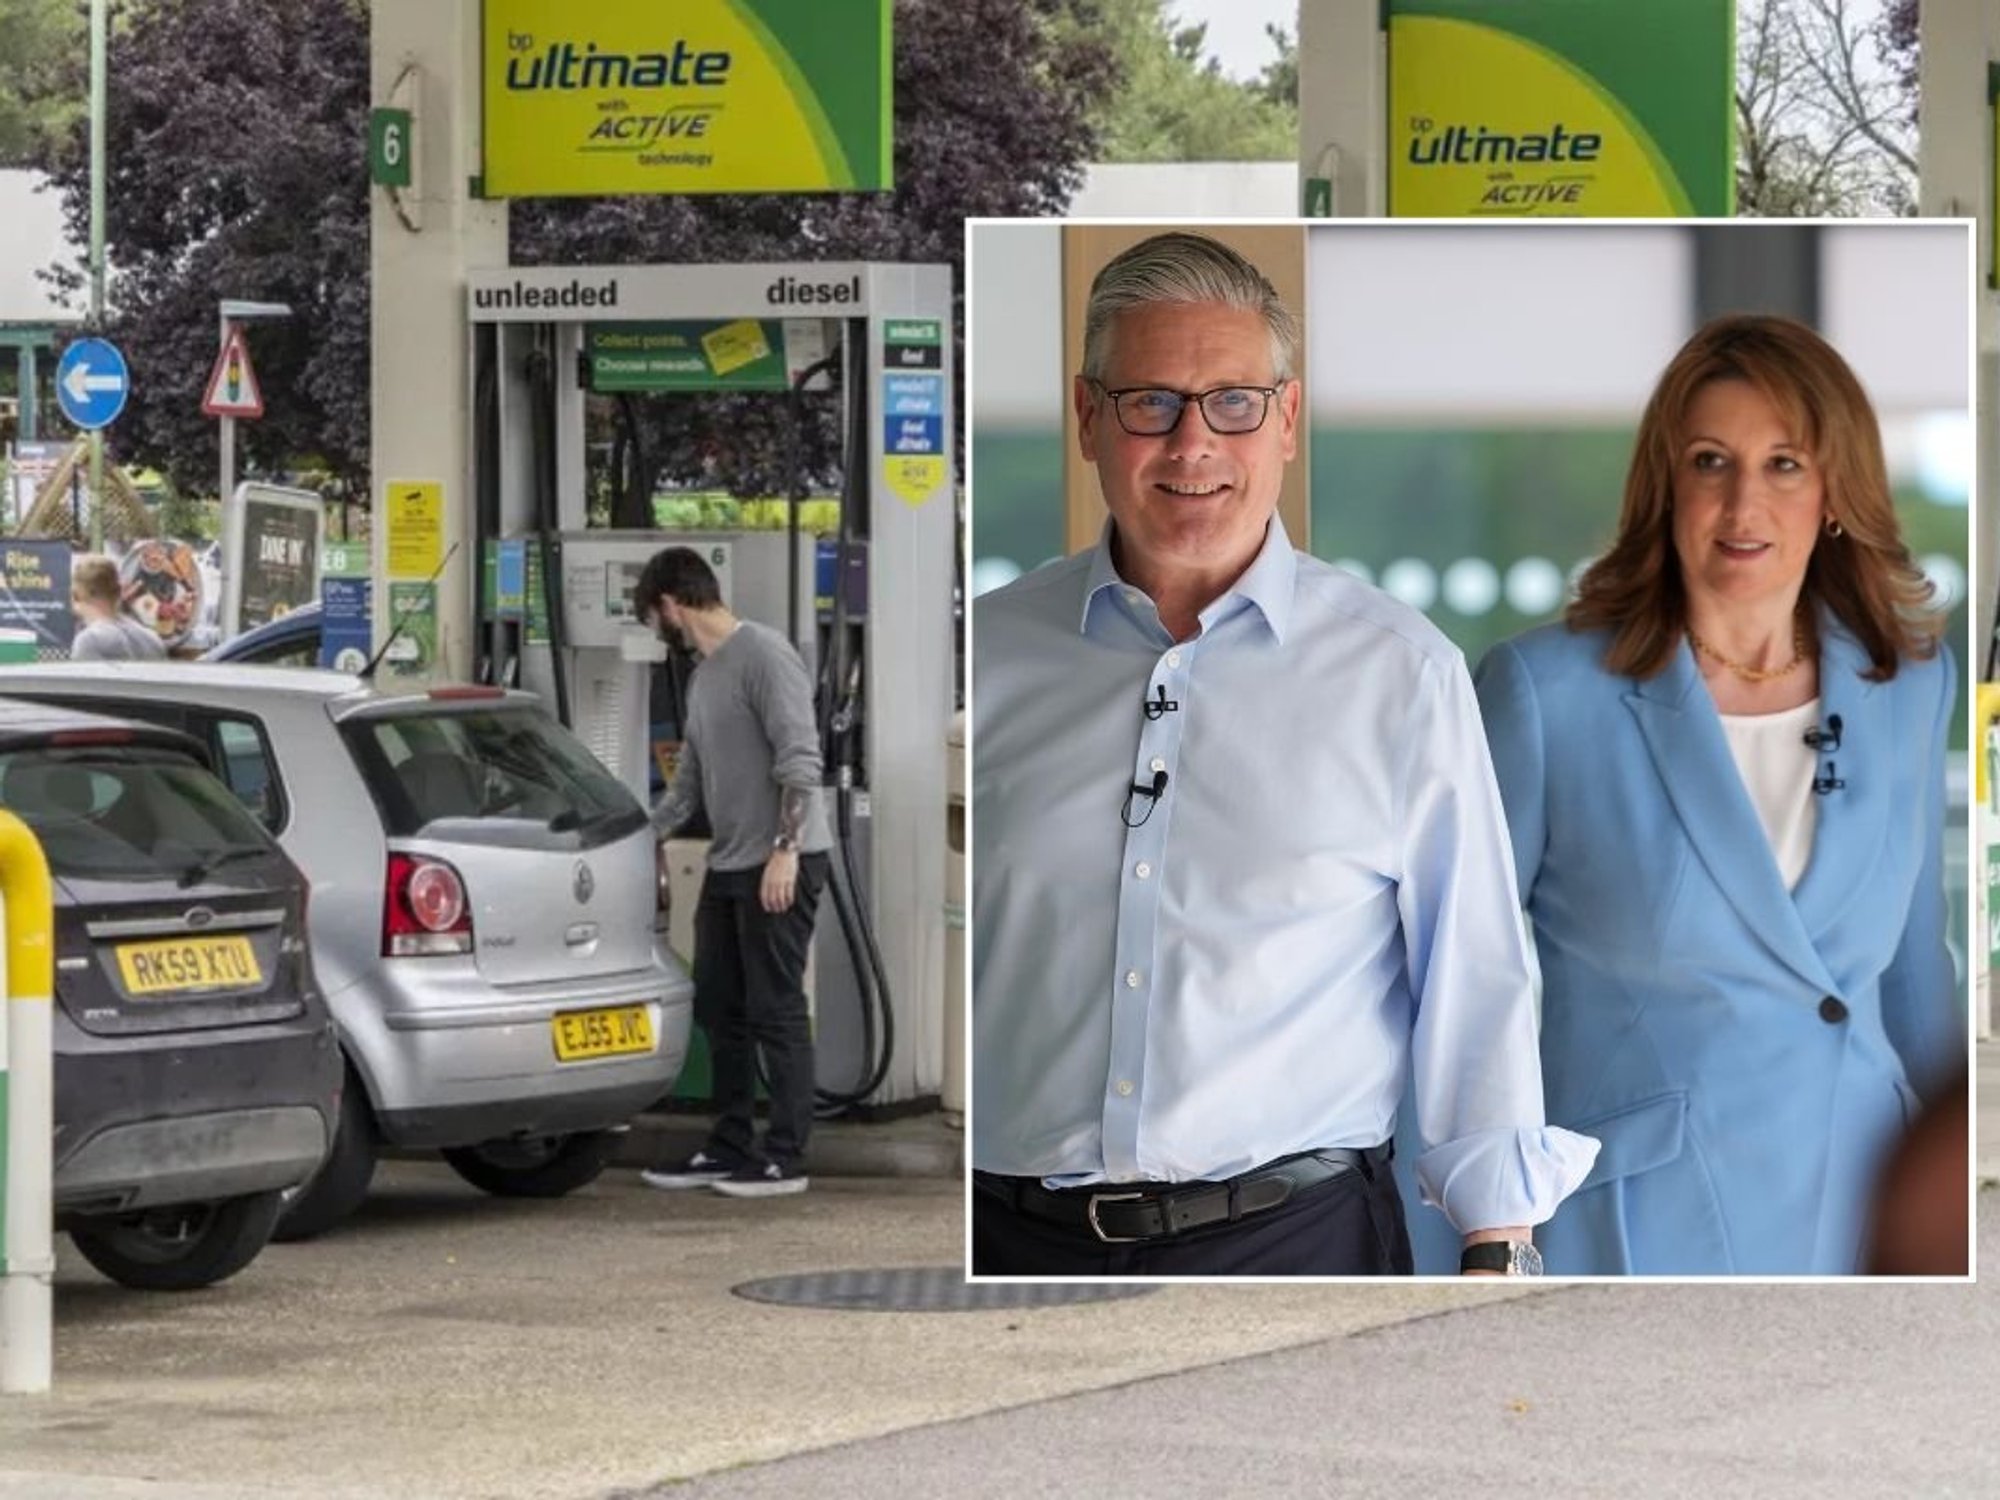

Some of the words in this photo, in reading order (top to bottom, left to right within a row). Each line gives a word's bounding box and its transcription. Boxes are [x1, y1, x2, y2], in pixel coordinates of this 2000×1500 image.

[508, 30, 533, 51] bp
[508, 40, 730, 90] ultimate
[597, 100, 629, 111] with
[590, 114, 709, 139] ACTIVE
[384, 123, 400, 165] 6
[1408, 124, 1601, 164] ultimate
[638, 151, 713, 167] technology
[1481, 183, 1584, 204] ACTIVE
[475, 281, 617, 309] unleaded
[766, 276, 861, 305] diesel
[712, 547, 725, 565] 6
[131, 945, 200, 987] RK59
[204, 943, 249, 979] XTU
